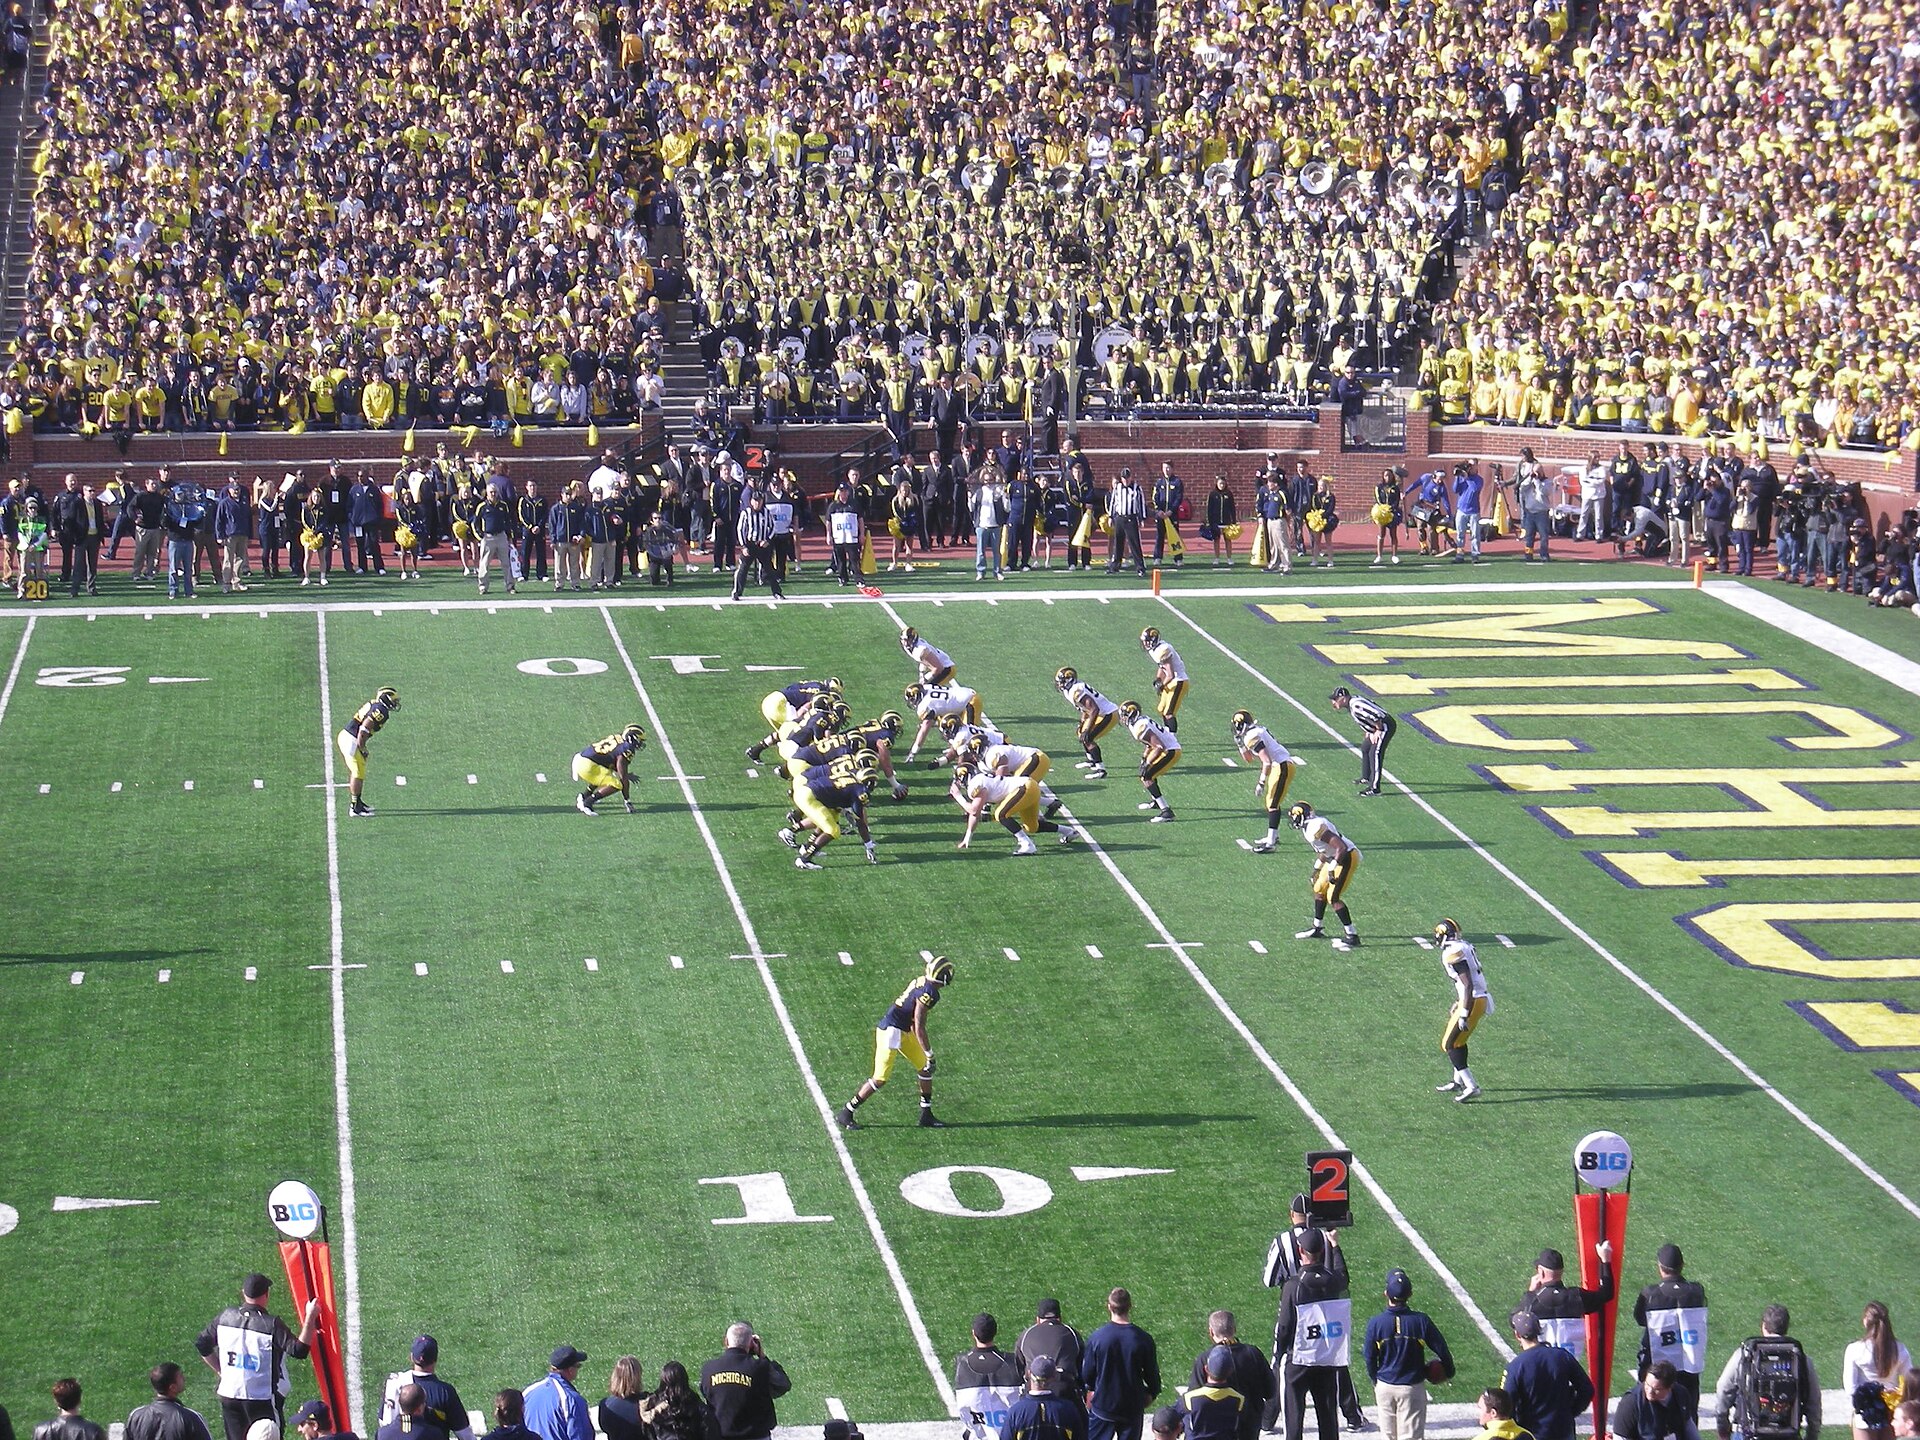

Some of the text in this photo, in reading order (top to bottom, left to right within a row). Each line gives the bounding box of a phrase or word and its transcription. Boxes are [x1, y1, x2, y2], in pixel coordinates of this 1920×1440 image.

[88, 390, 103, 407] 20
[745, 447, 763, 468] 2
[25, 579, 48, 600] 20
[1311, 1157, 1348, 1202] 2
[711, 1371, 752, 1388] MICHIGAN
